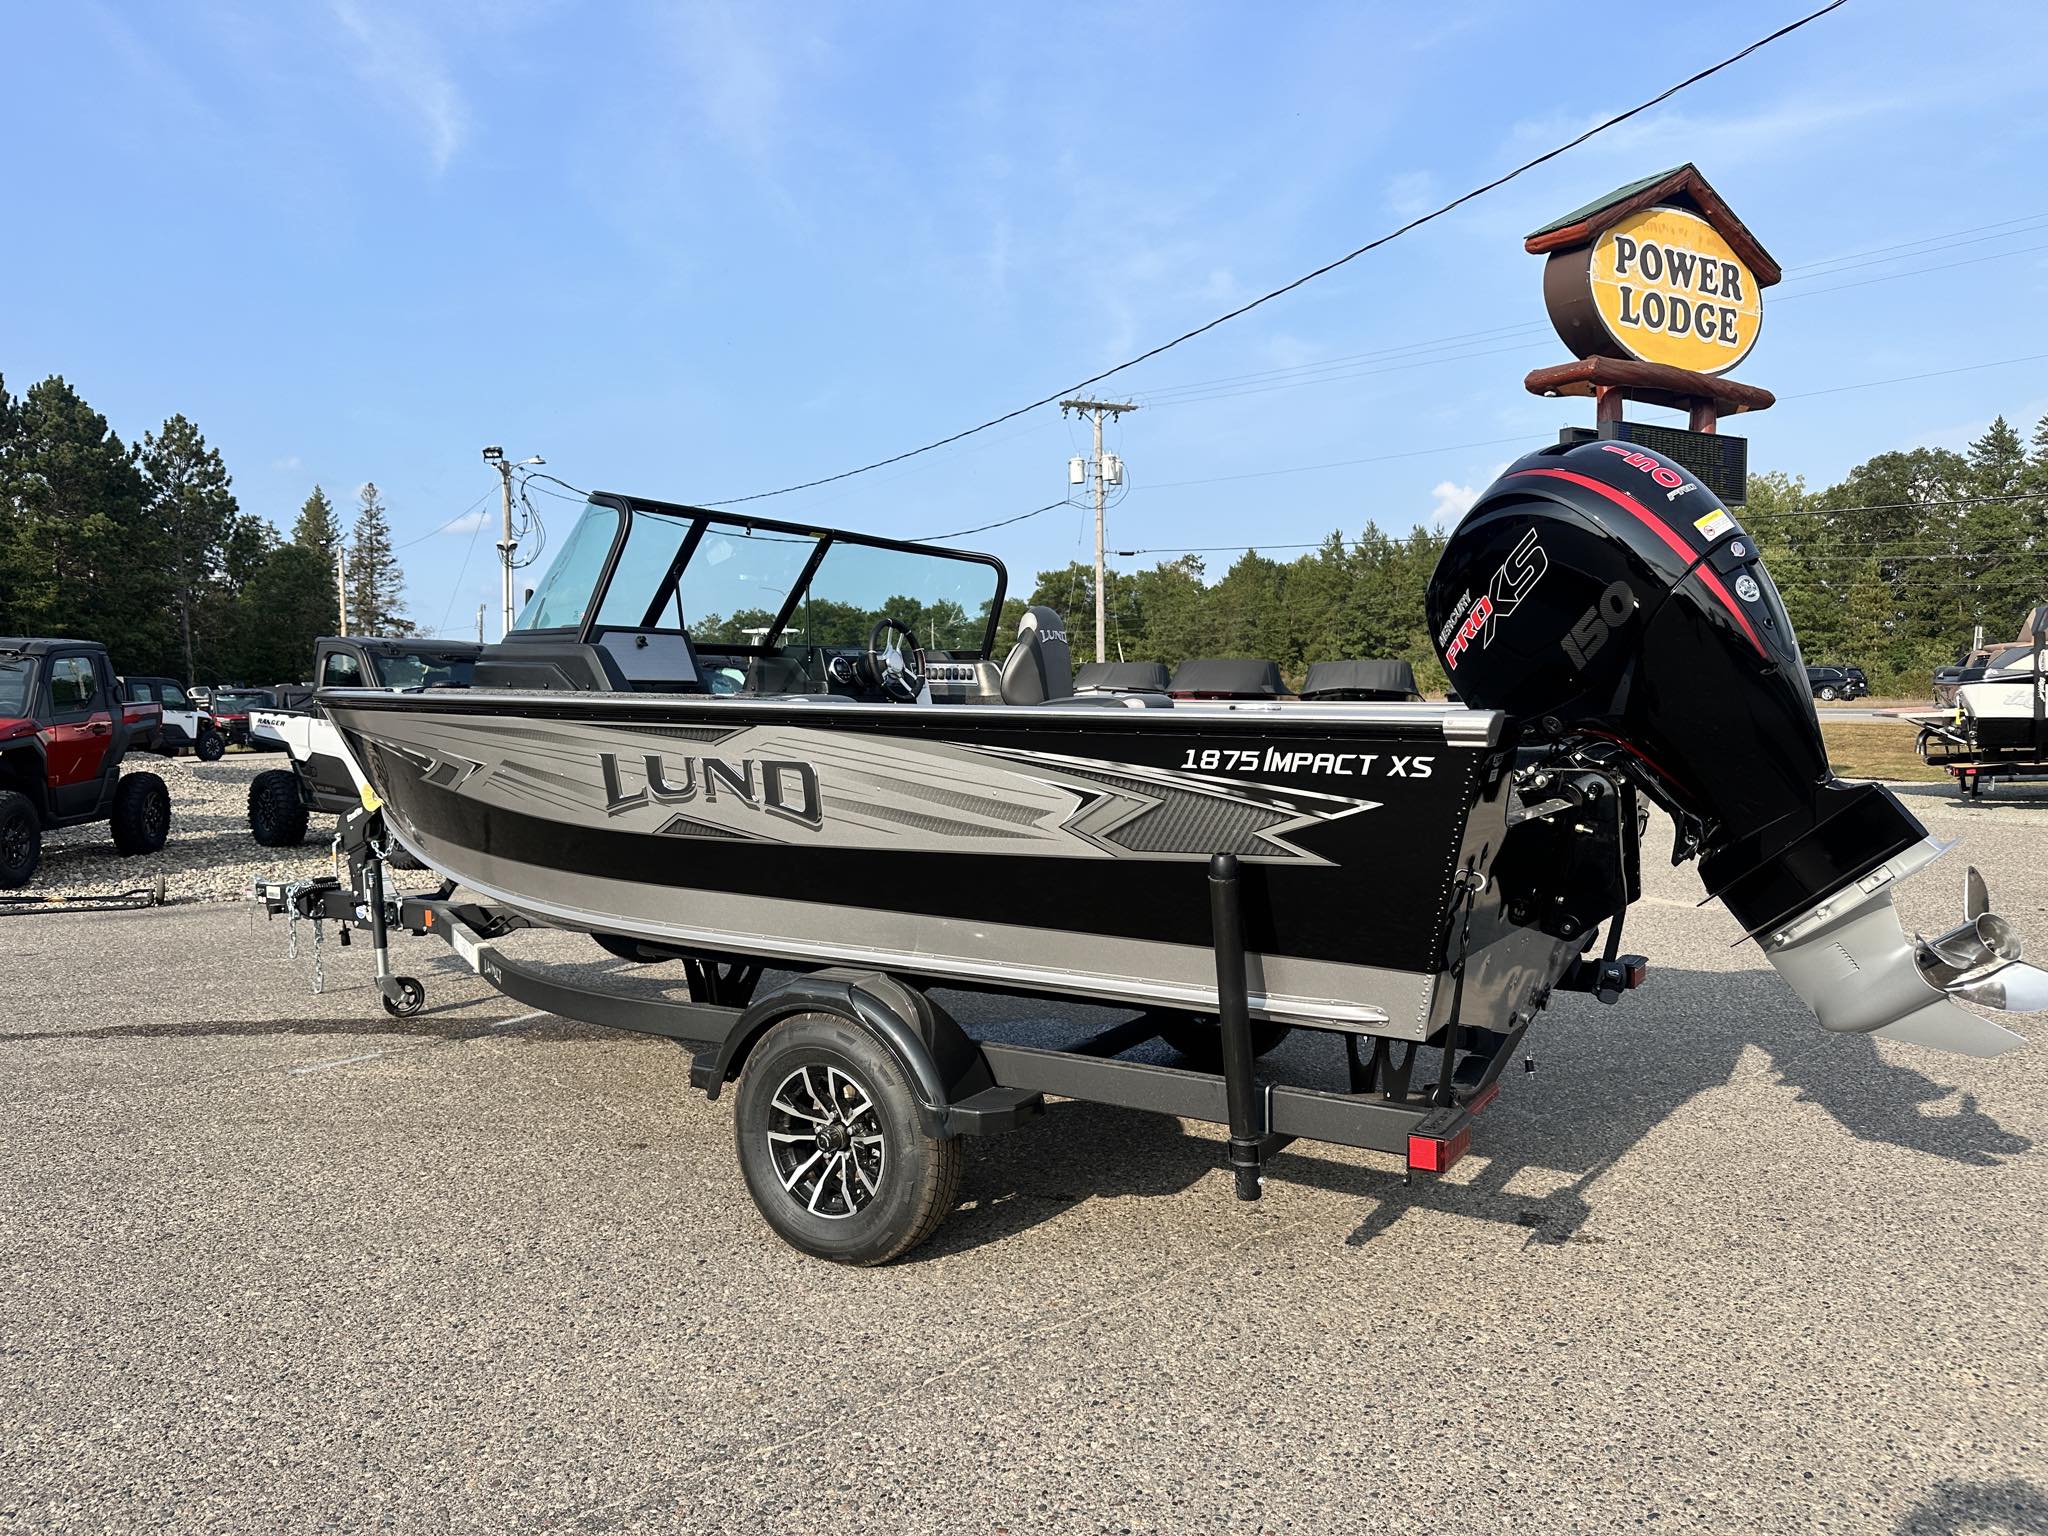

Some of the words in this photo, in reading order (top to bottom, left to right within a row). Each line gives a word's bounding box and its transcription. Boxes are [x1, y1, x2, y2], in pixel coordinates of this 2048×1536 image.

[1615, 236, 1743, 301] POWER
[1619, 286, 1738, 344] LODGE
[1601, 445, 1683, 488] 150
[1438, 587, 1472, 649] MERCURY
[1445, 594, 1494, 671] PRO
[1484, 527, 1548, 650] XS
[1560, 580, 1636, 672] 150
[257, 717, 286, 727] RANGER
[596, 753, 824, 832] LUND
[1181, 749, 1260, 771] 1875
[1263, 746, 1379, 776] IMPACT
[1386, 755, 1436, 778] XS
